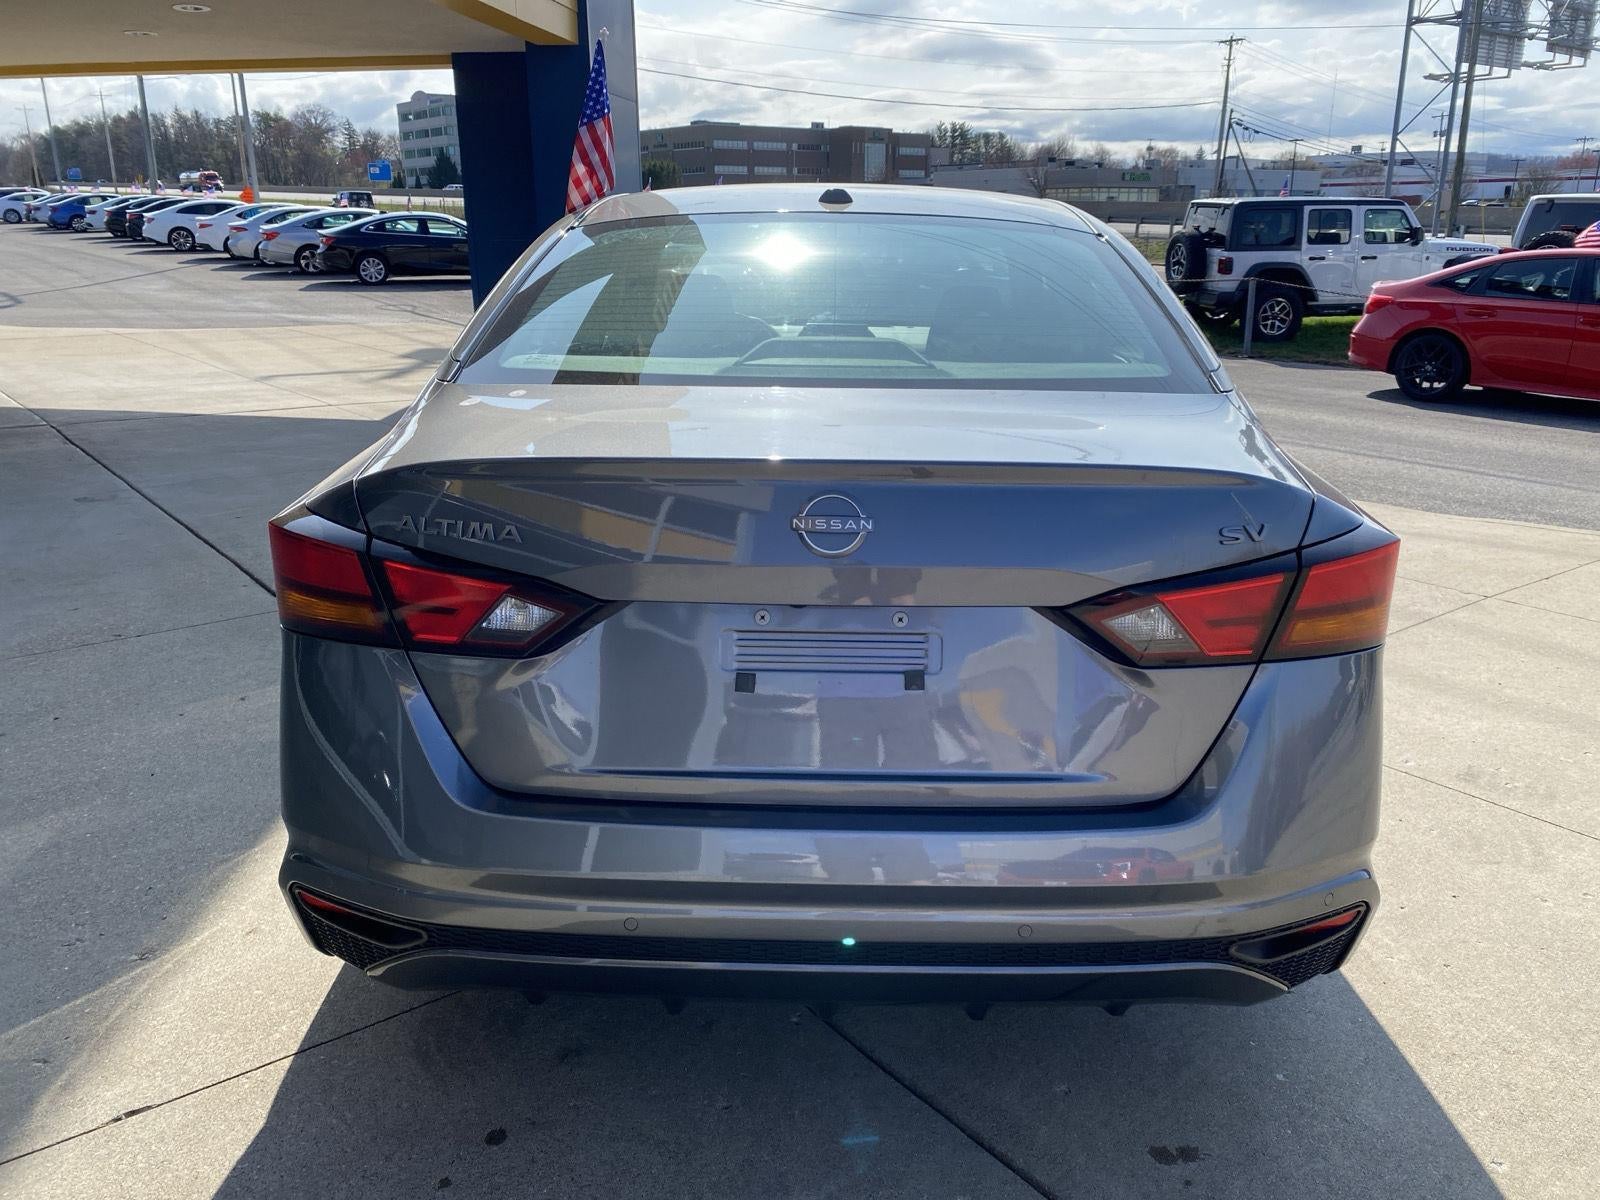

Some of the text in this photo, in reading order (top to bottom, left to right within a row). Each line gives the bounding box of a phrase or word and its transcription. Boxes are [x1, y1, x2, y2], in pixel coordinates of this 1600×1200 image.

[399, 515, 522, 543] ALTIMA
[792, 518, 873, 530] NISSAN
[1218, 523, 1266, 546] SV
